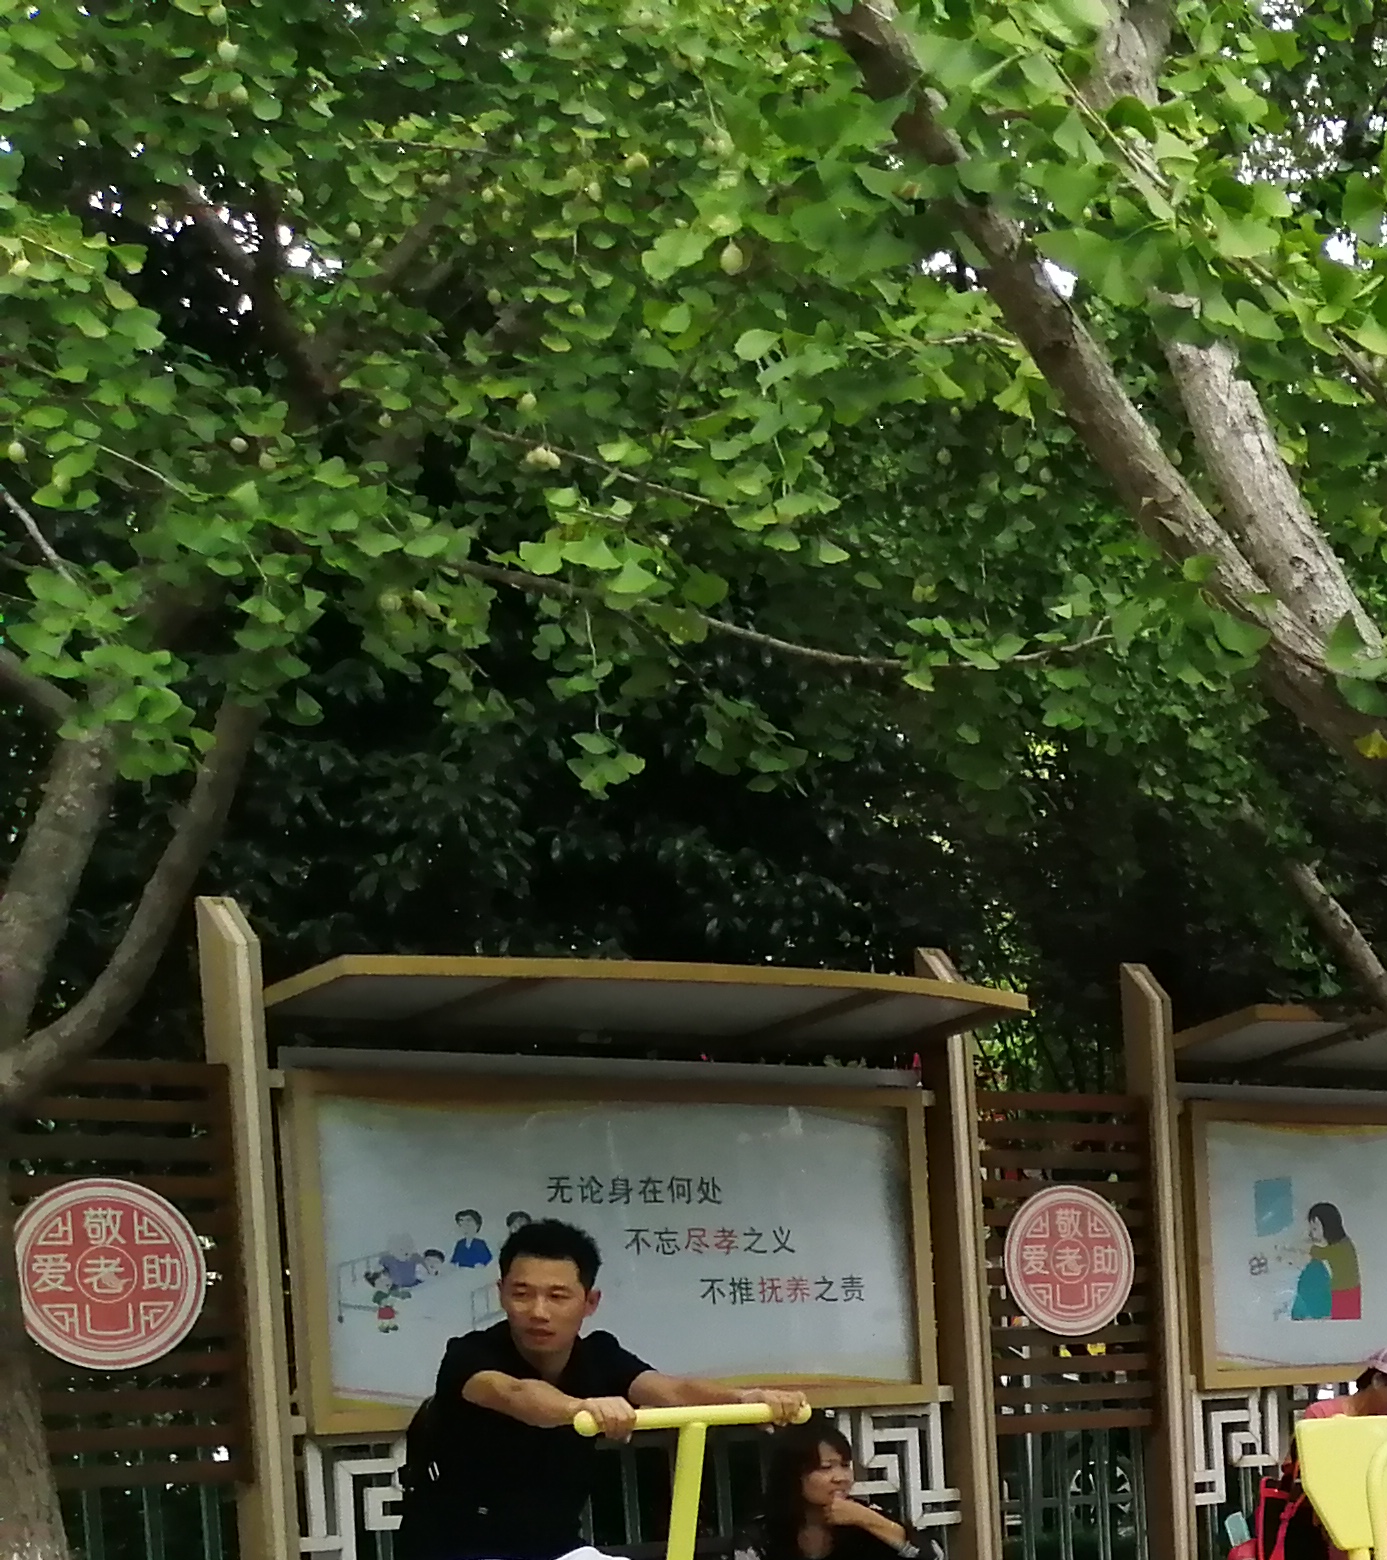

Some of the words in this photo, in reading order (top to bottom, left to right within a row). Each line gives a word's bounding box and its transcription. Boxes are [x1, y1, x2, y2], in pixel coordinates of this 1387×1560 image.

[547, 1176, 722, 1204] 无论身在何处
[82, 1207, 126, 1245] 敬
[1055, 1208, 1083, 1239] 敬
[624, 1226, 796, 1256] 不忘尽孝之义
[699, 1275, 866, 1305] 不推抚养之责
